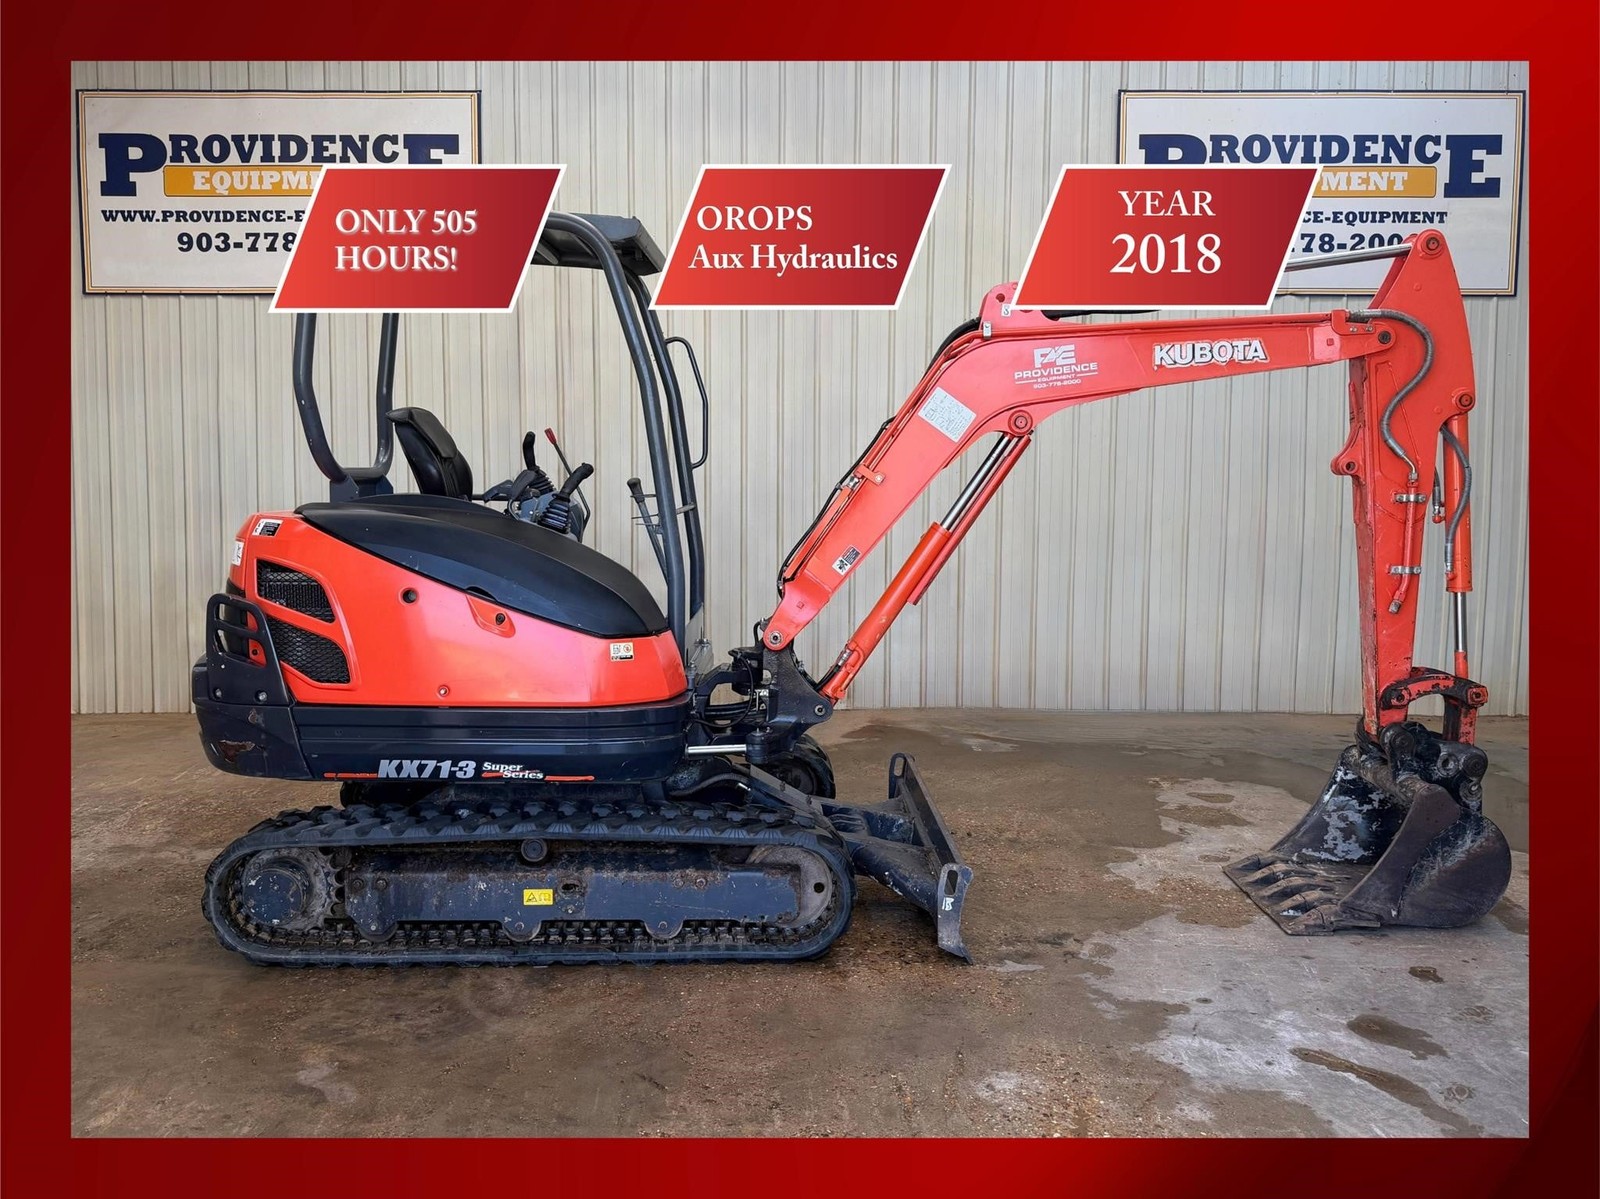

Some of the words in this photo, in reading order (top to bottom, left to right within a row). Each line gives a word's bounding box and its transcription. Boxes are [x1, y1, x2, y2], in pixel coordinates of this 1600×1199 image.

[1319, 171, 1408, 191] MENT
[1154, 340, 1267, 365] KUBOTA
[1014, 362, 1098, 380] PROVIDENCE
[1037, 373, 1076, 383] EQUIPMENT
[377, 759, 477, 778] KX71-3
[482, 761, 523, 773] Super
[502, 770, 544, 780] Series
